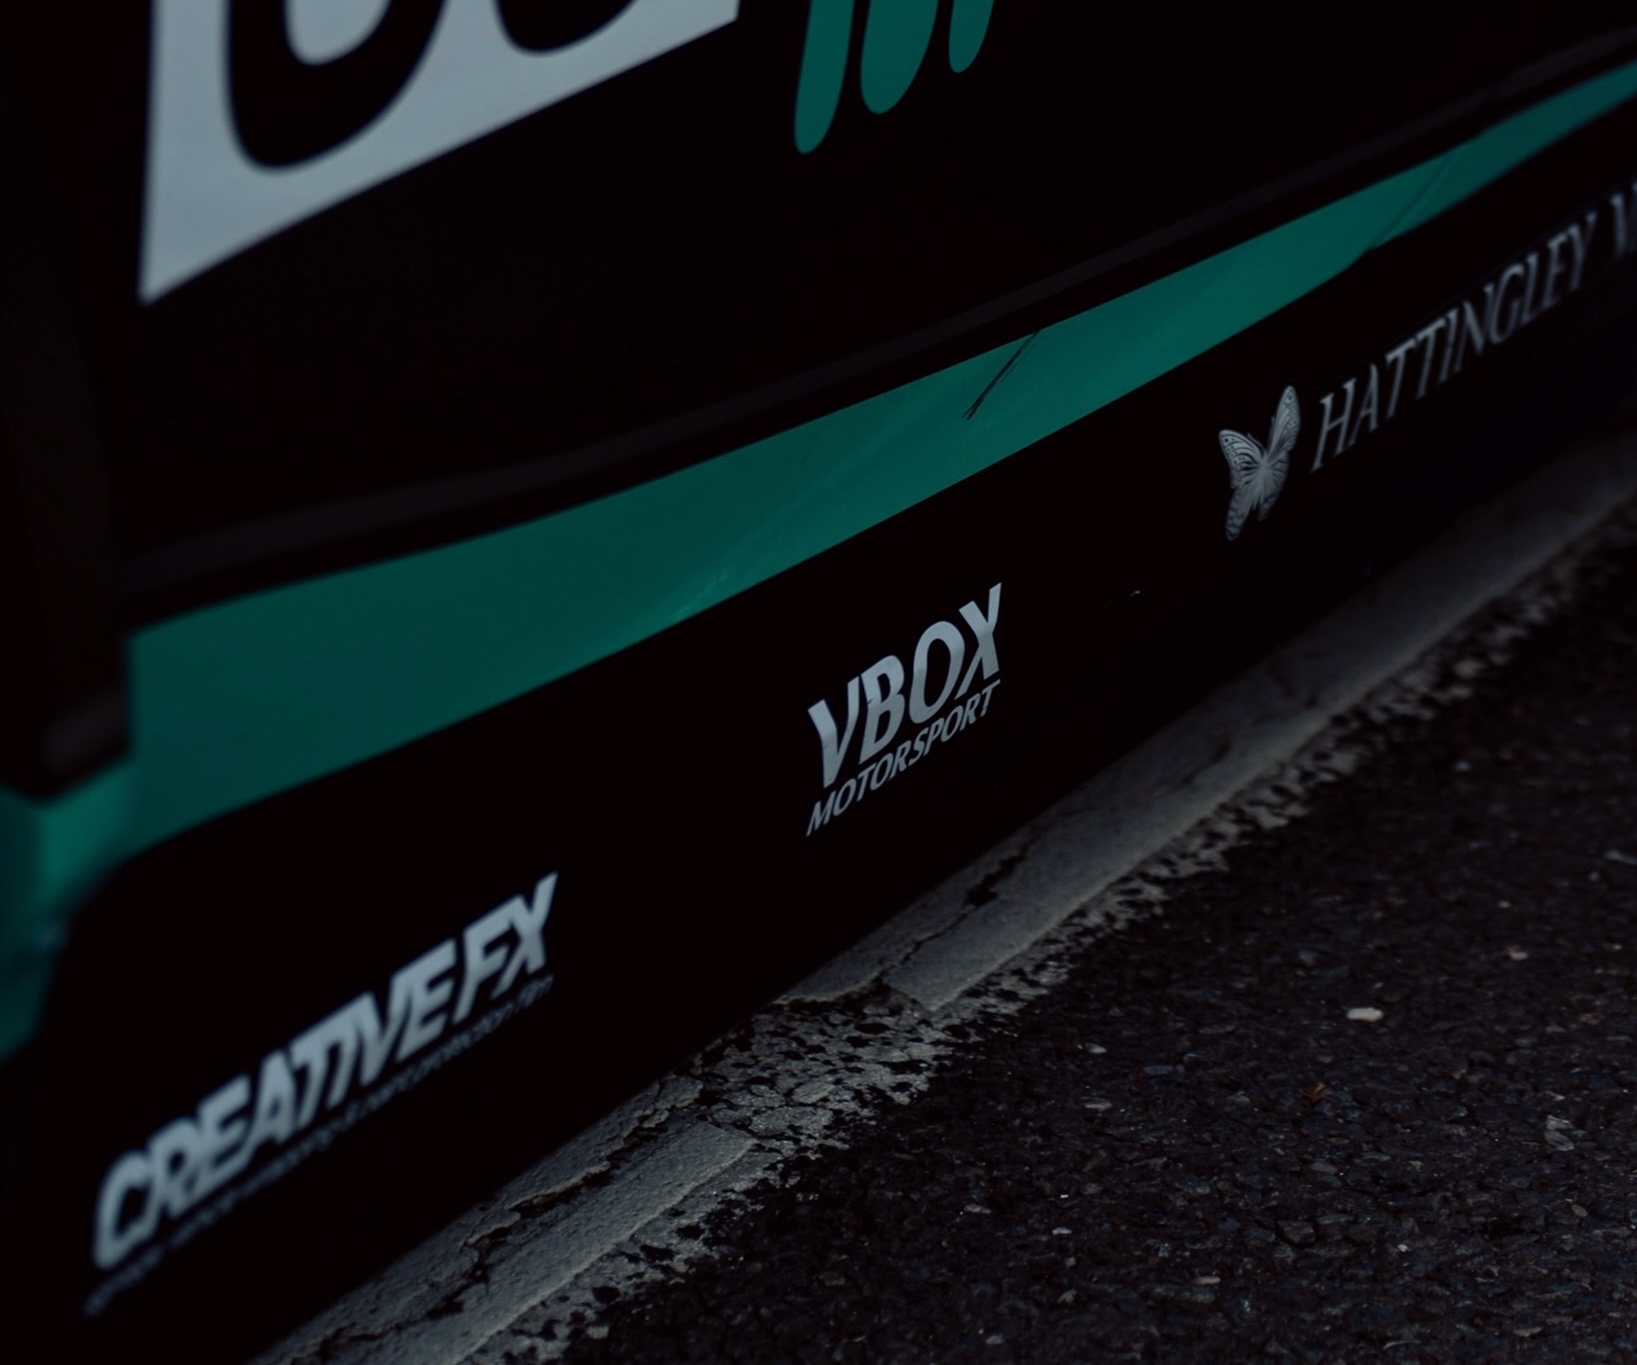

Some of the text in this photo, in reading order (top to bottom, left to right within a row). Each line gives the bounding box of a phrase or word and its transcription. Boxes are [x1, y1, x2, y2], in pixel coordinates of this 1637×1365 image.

[1311, 210, 1597, 473] HATTINGLEY
[806, 678, 1002, 837] MOTORSPORT
[807, 582, 1002, 789] VBOX
